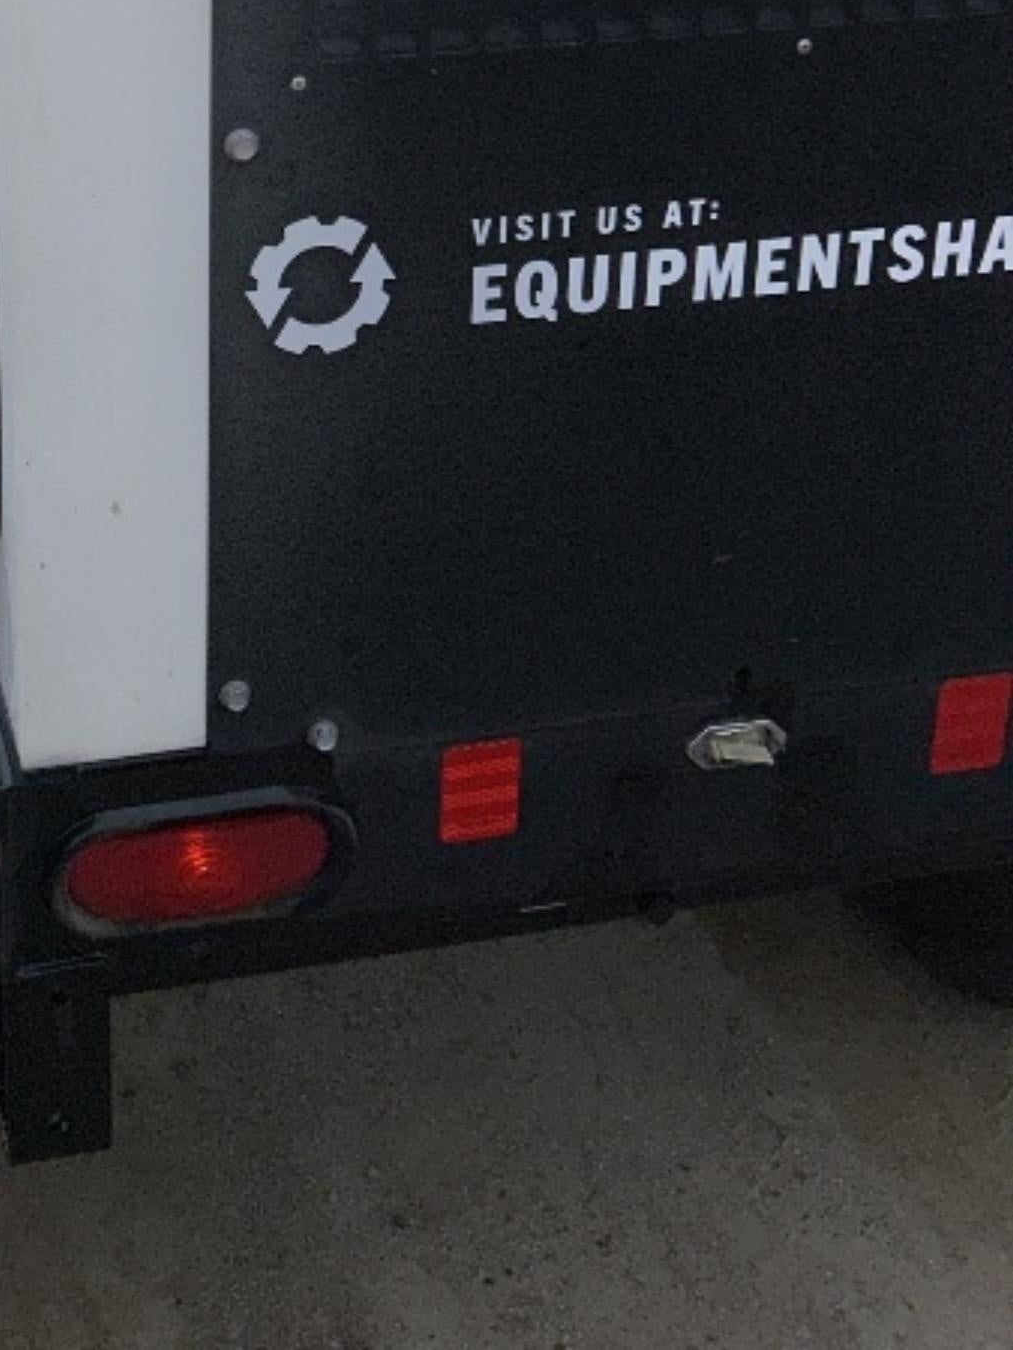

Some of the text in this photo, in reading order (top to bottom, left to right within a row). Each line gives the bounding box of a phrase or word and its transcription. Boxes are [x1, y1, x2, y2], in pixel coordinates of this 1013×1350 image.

[471, 198, 720, 246] VISIT US AT:
[470, 215, 1013, 326] EQUIPMENTSHA
